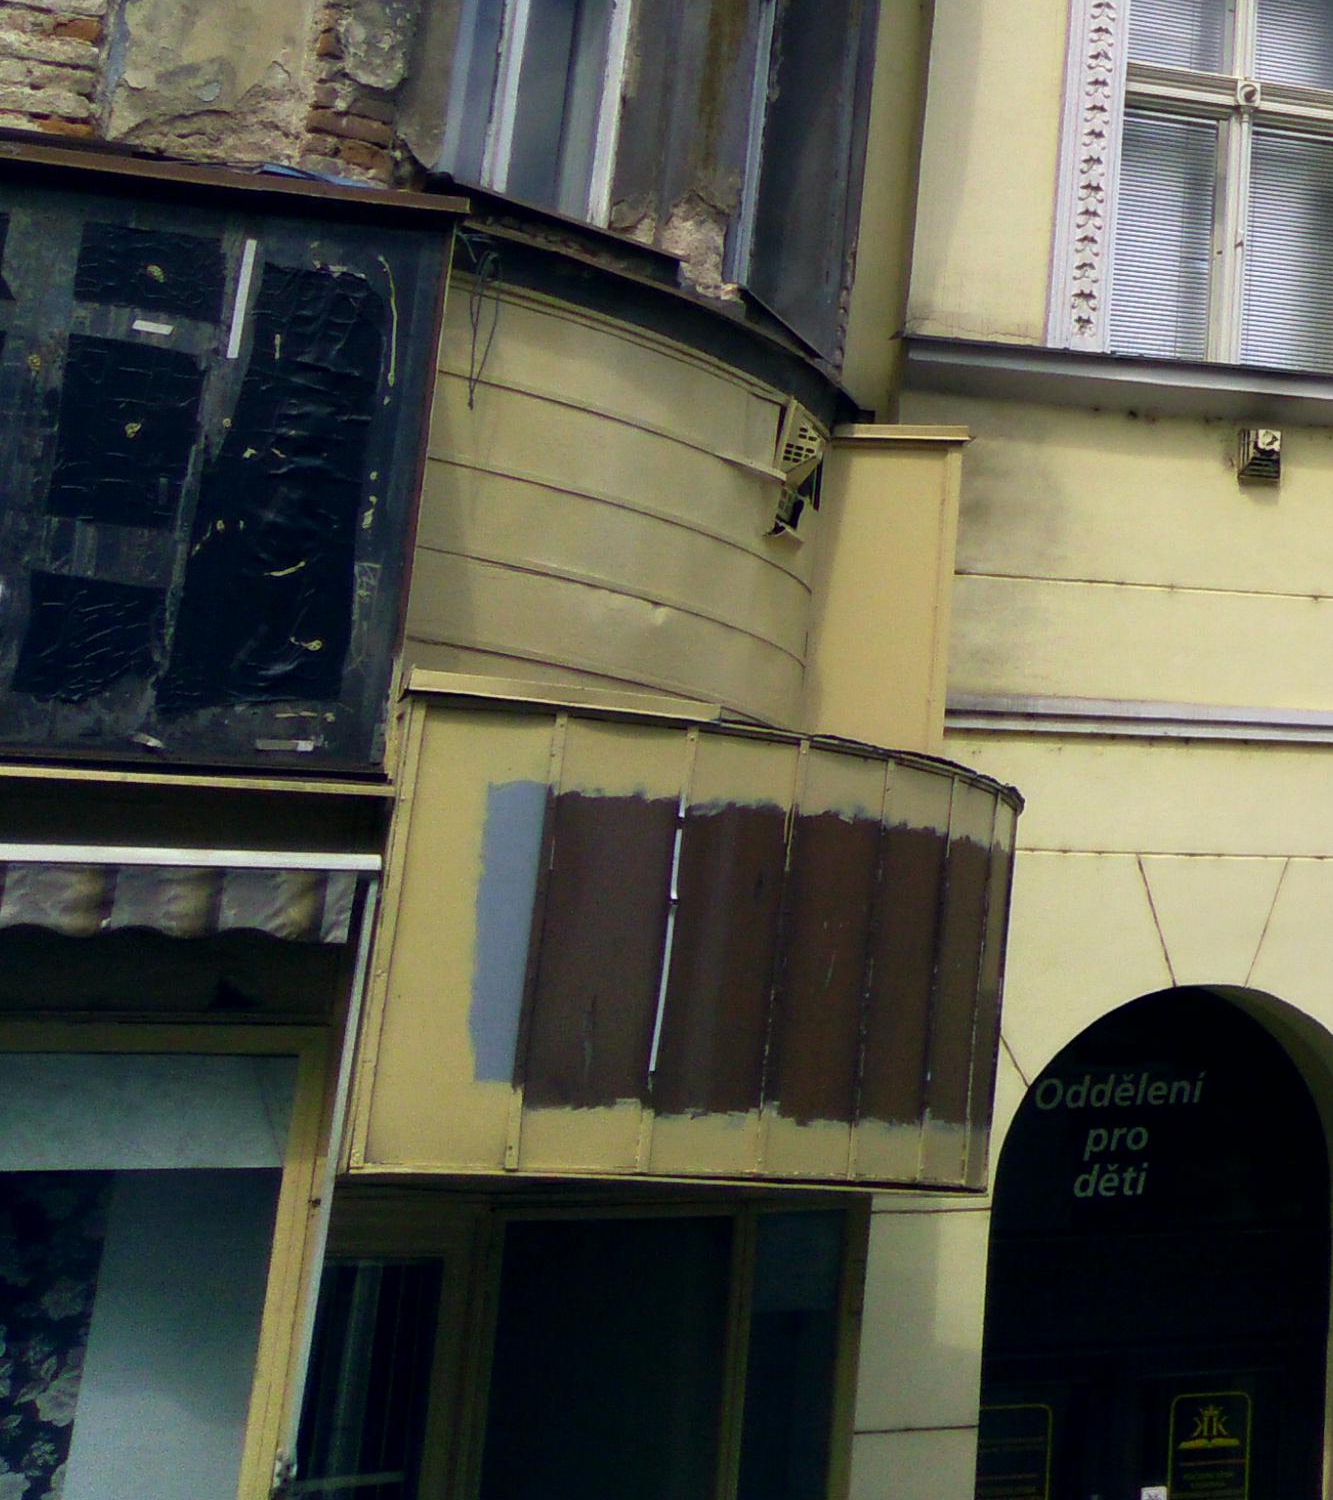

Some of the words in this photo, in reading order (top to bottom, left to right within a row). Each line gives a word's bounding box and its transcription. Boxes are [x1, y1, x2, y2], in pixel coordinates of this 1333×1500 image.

[1034, 1071, 1207, 1111] Oddělení
[1083, 1126, 1149, 1162] pro
[1073, 1162, 1149, 1198] děti
